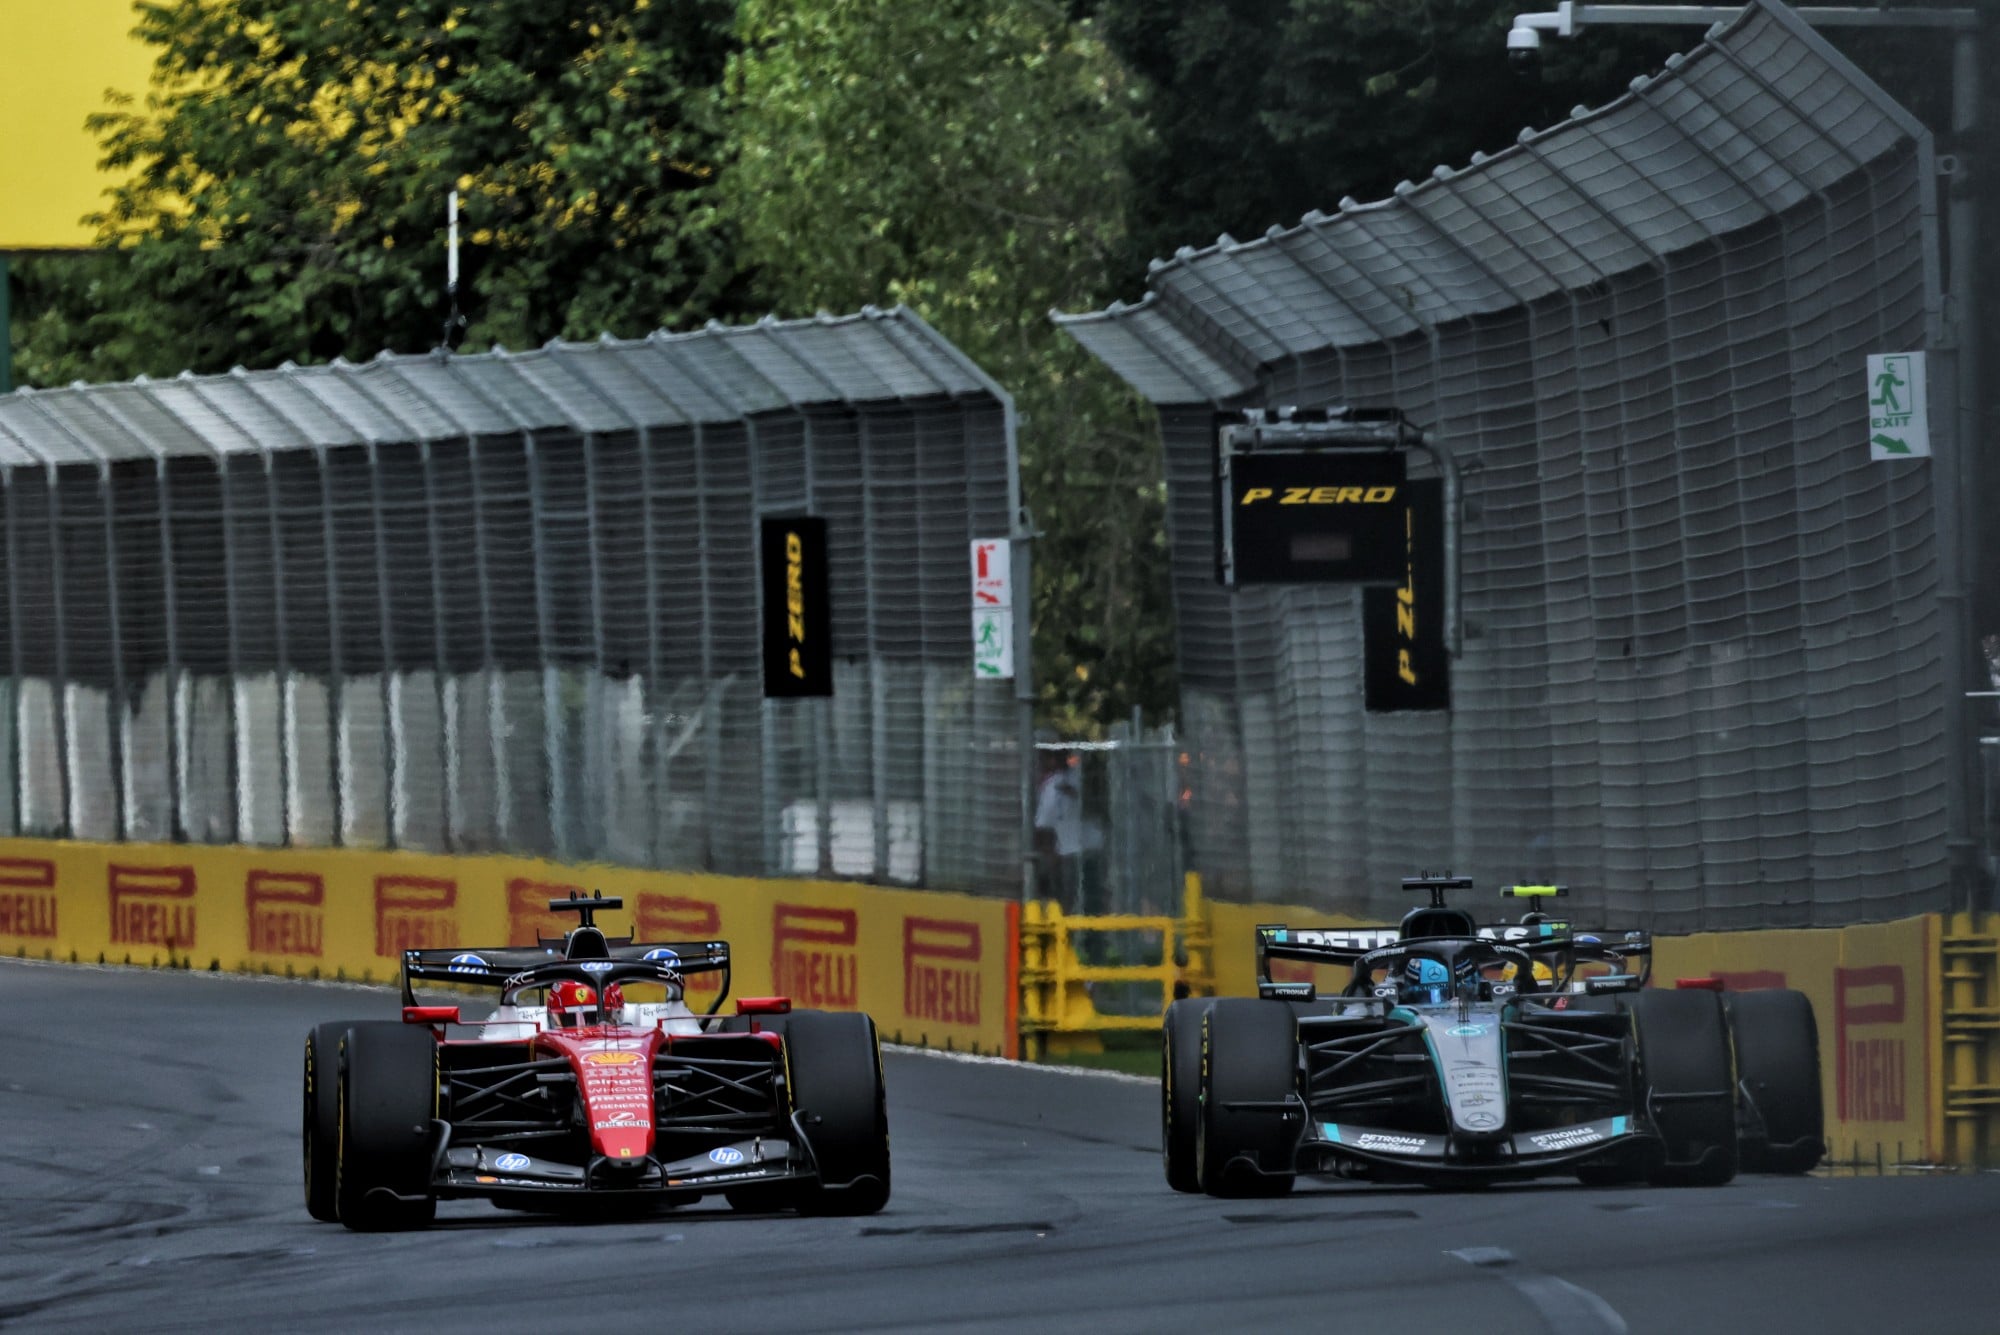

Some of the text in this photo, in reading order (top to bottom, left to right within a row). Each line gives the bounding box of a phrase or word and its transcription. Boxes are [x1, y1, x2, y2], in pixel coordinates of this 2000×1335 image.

[1871, 416, 1911, 428] EXIT
[1241, 486, 1396, 504] P ZERO
[786, 531, 805, 679] P ZERO
[108, 863, 195, 949] PIRELLI
[246, 869, 325, 956] PIRELLI
[772, 903, 857, 1008] PIRELLI
[904, 915, 981, 1025] PIRELLI
[1275, 988, 1310, 996] PETRONAS
[1834, 964, 1905, 1123] PIRELLI
[585, 1066, 645, 1077] IBM
[1360, 1133, 1426, 1146] PETRONAS
[1530, 1127, 1594, 1143] PETRONAS
[1537, 1133, 1603, 1150] Syntium
[1356, 1139, 1421, 1153] Syntium
